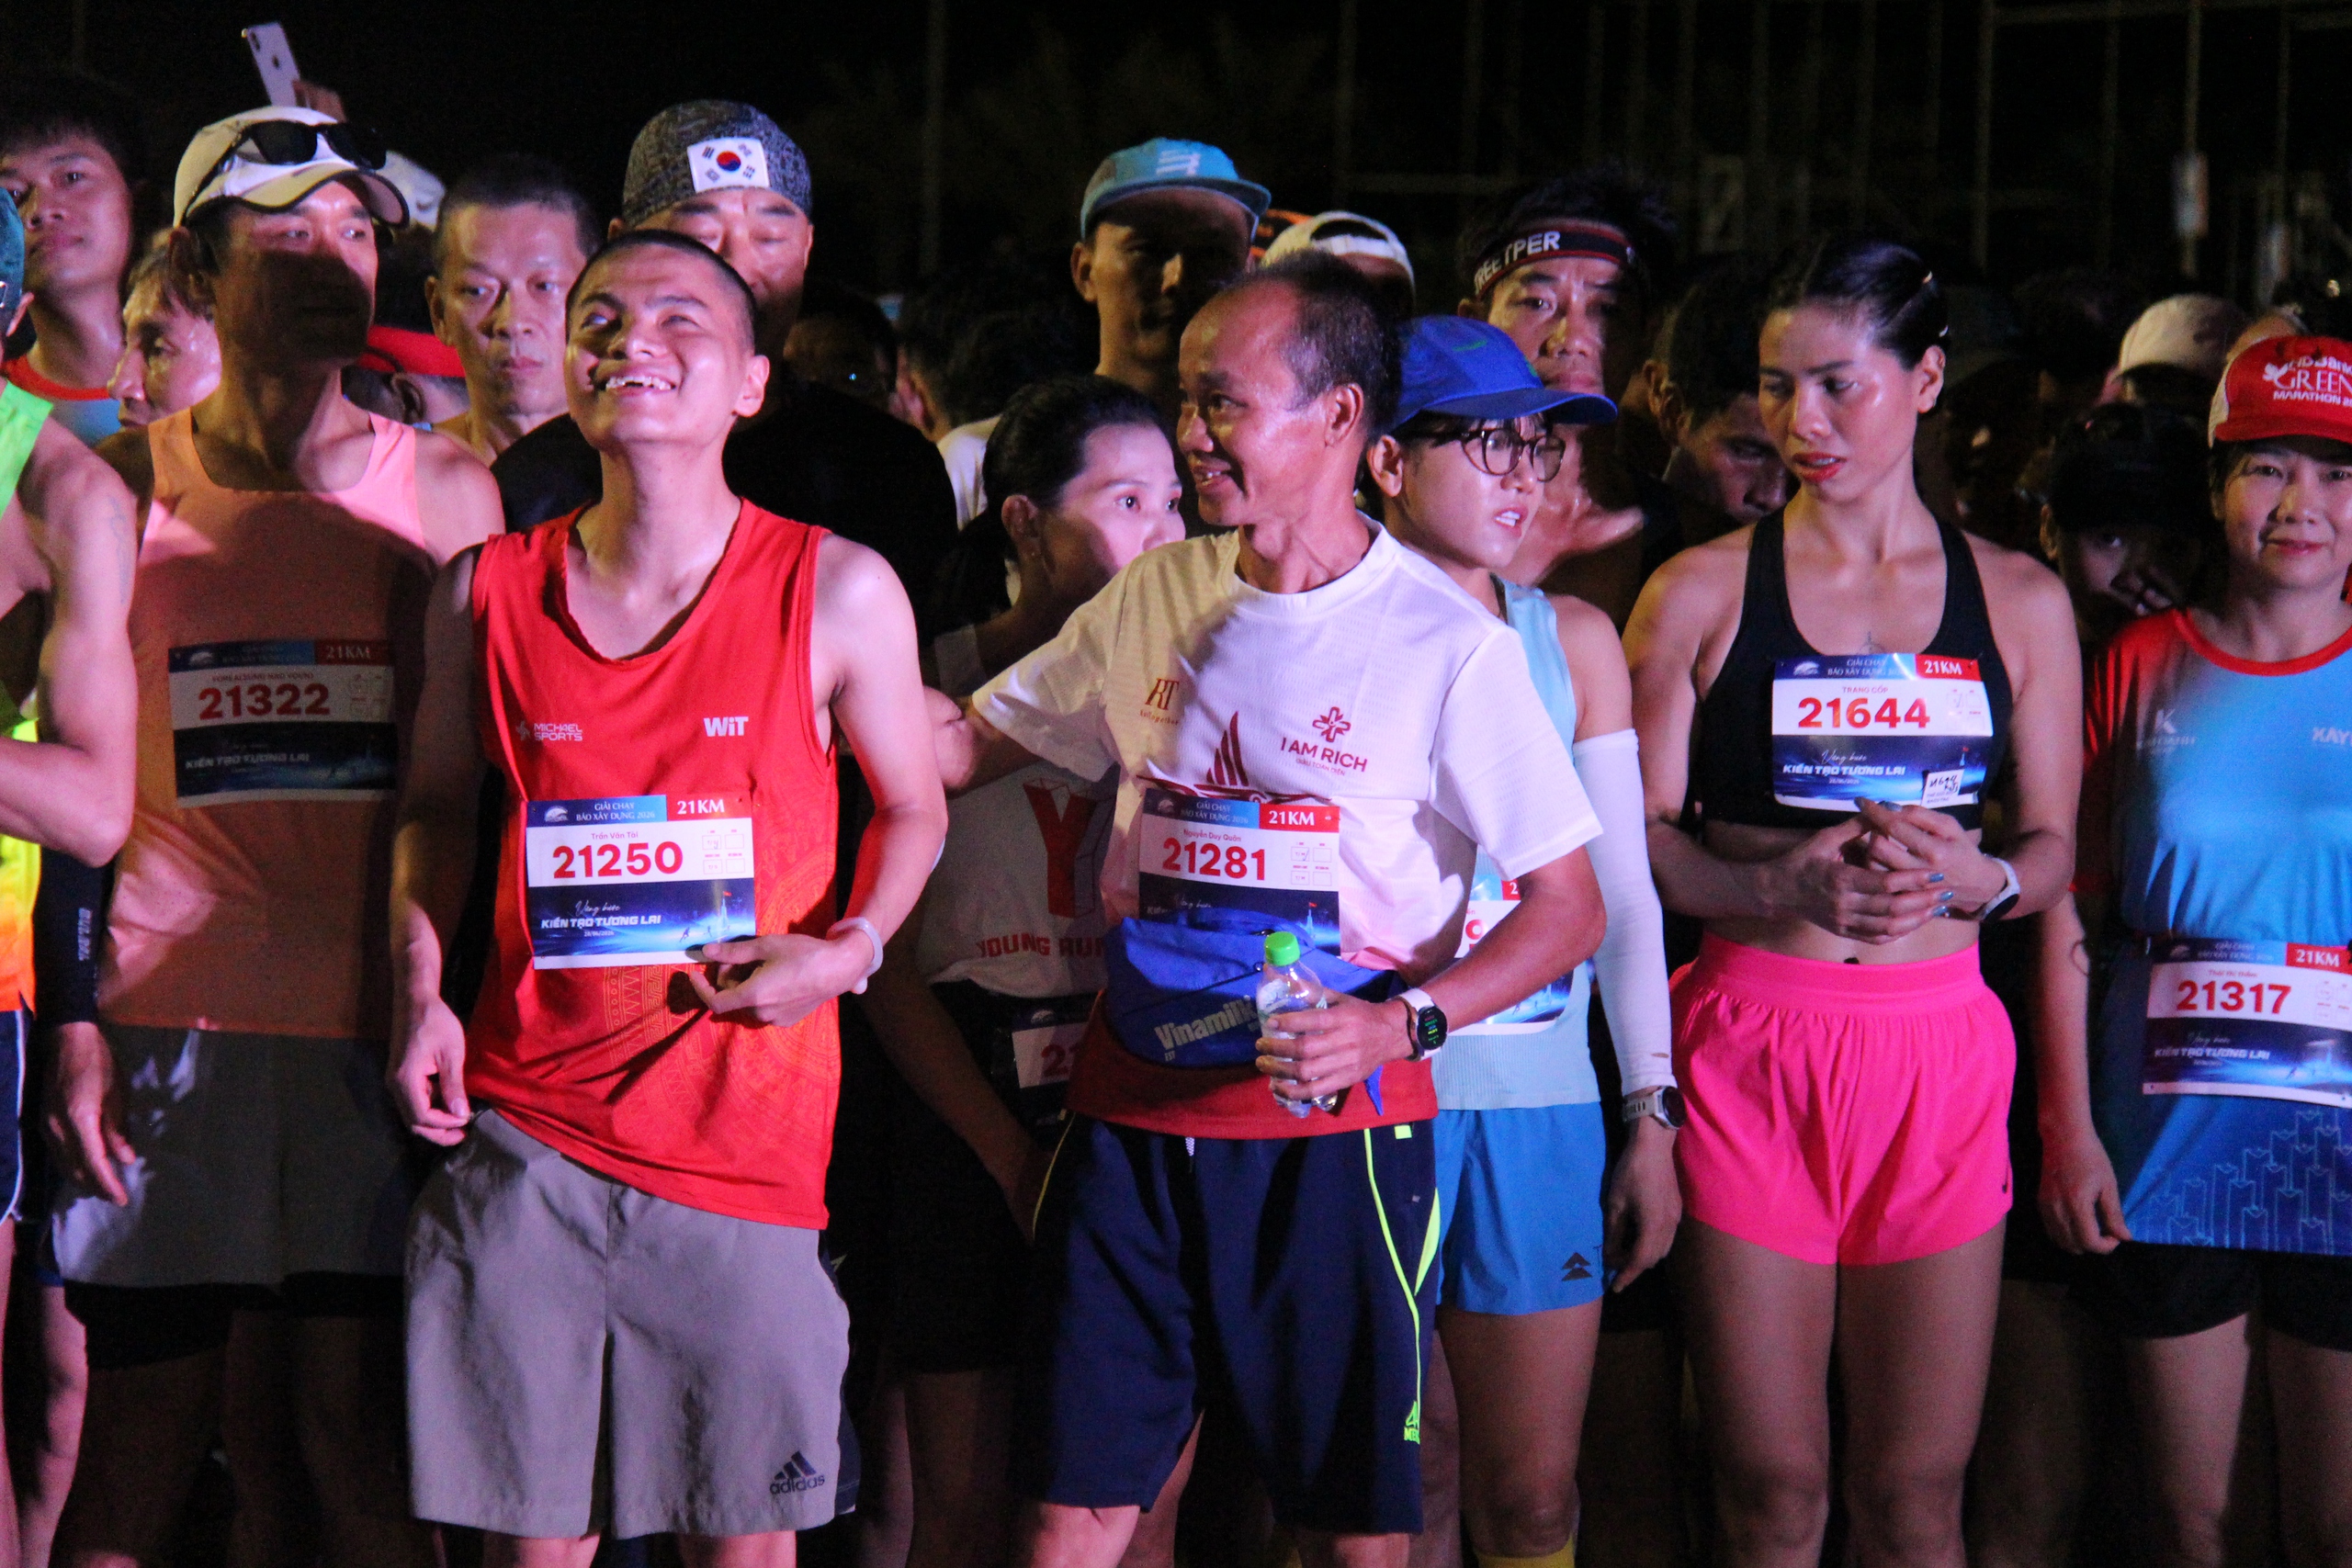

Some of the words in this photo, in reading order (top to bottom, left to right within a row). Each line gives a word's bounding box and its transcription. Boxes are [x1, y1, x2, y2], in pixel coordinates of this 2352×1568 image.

[2273, 390, 2341, 405] MARATHON
[325, 645, 371, 660] 21KM
[1924, 660, 1962, 675] 21KM
[198, 682, 330, 720] 21322
[1798, 696, 1930, 728] 21644
[534, 723, 582, 733] MICHAEL
[534, 732, 582, 741] SPORTS
[1281, 738, 1287, 751] I
[1288, 739, 1318, 758] AM
[1321, 747, 1367, 773] RICH
[1782, 762, 1814, 774] KIẾN
[1815, 764, 1840, 776] TẠO
[1885, 764, 1906, 775] LAI
[594, 801, 611, 811] GIẢI
[677, 799, 725, 815] 21KM
[576, 812, 592, 821] BÁO
[593, 811, 609, 820] XÂY
[637, 811, 655, 819] 2026
[1269, 810, 1315, 826] 21KM
[1208, 832, 1222, 840] Duy
[552, 840, 684, 879] 21250
[1162, 837, 1265, 880] 21281
[541, 917, 569, 929] KIẾN
[570, 918, 594, 930] TẠO
[640, 915, 662, 925] LAI
[976, 933, 1050, 958] YOUNG
[2296, 949, 2340, 967] 21KM
[2177, 980, 2291, 1014] 21317
[1154, 998, 1258, 1050] Vinamilk
[770, 1474, 825, 1495] adidas
